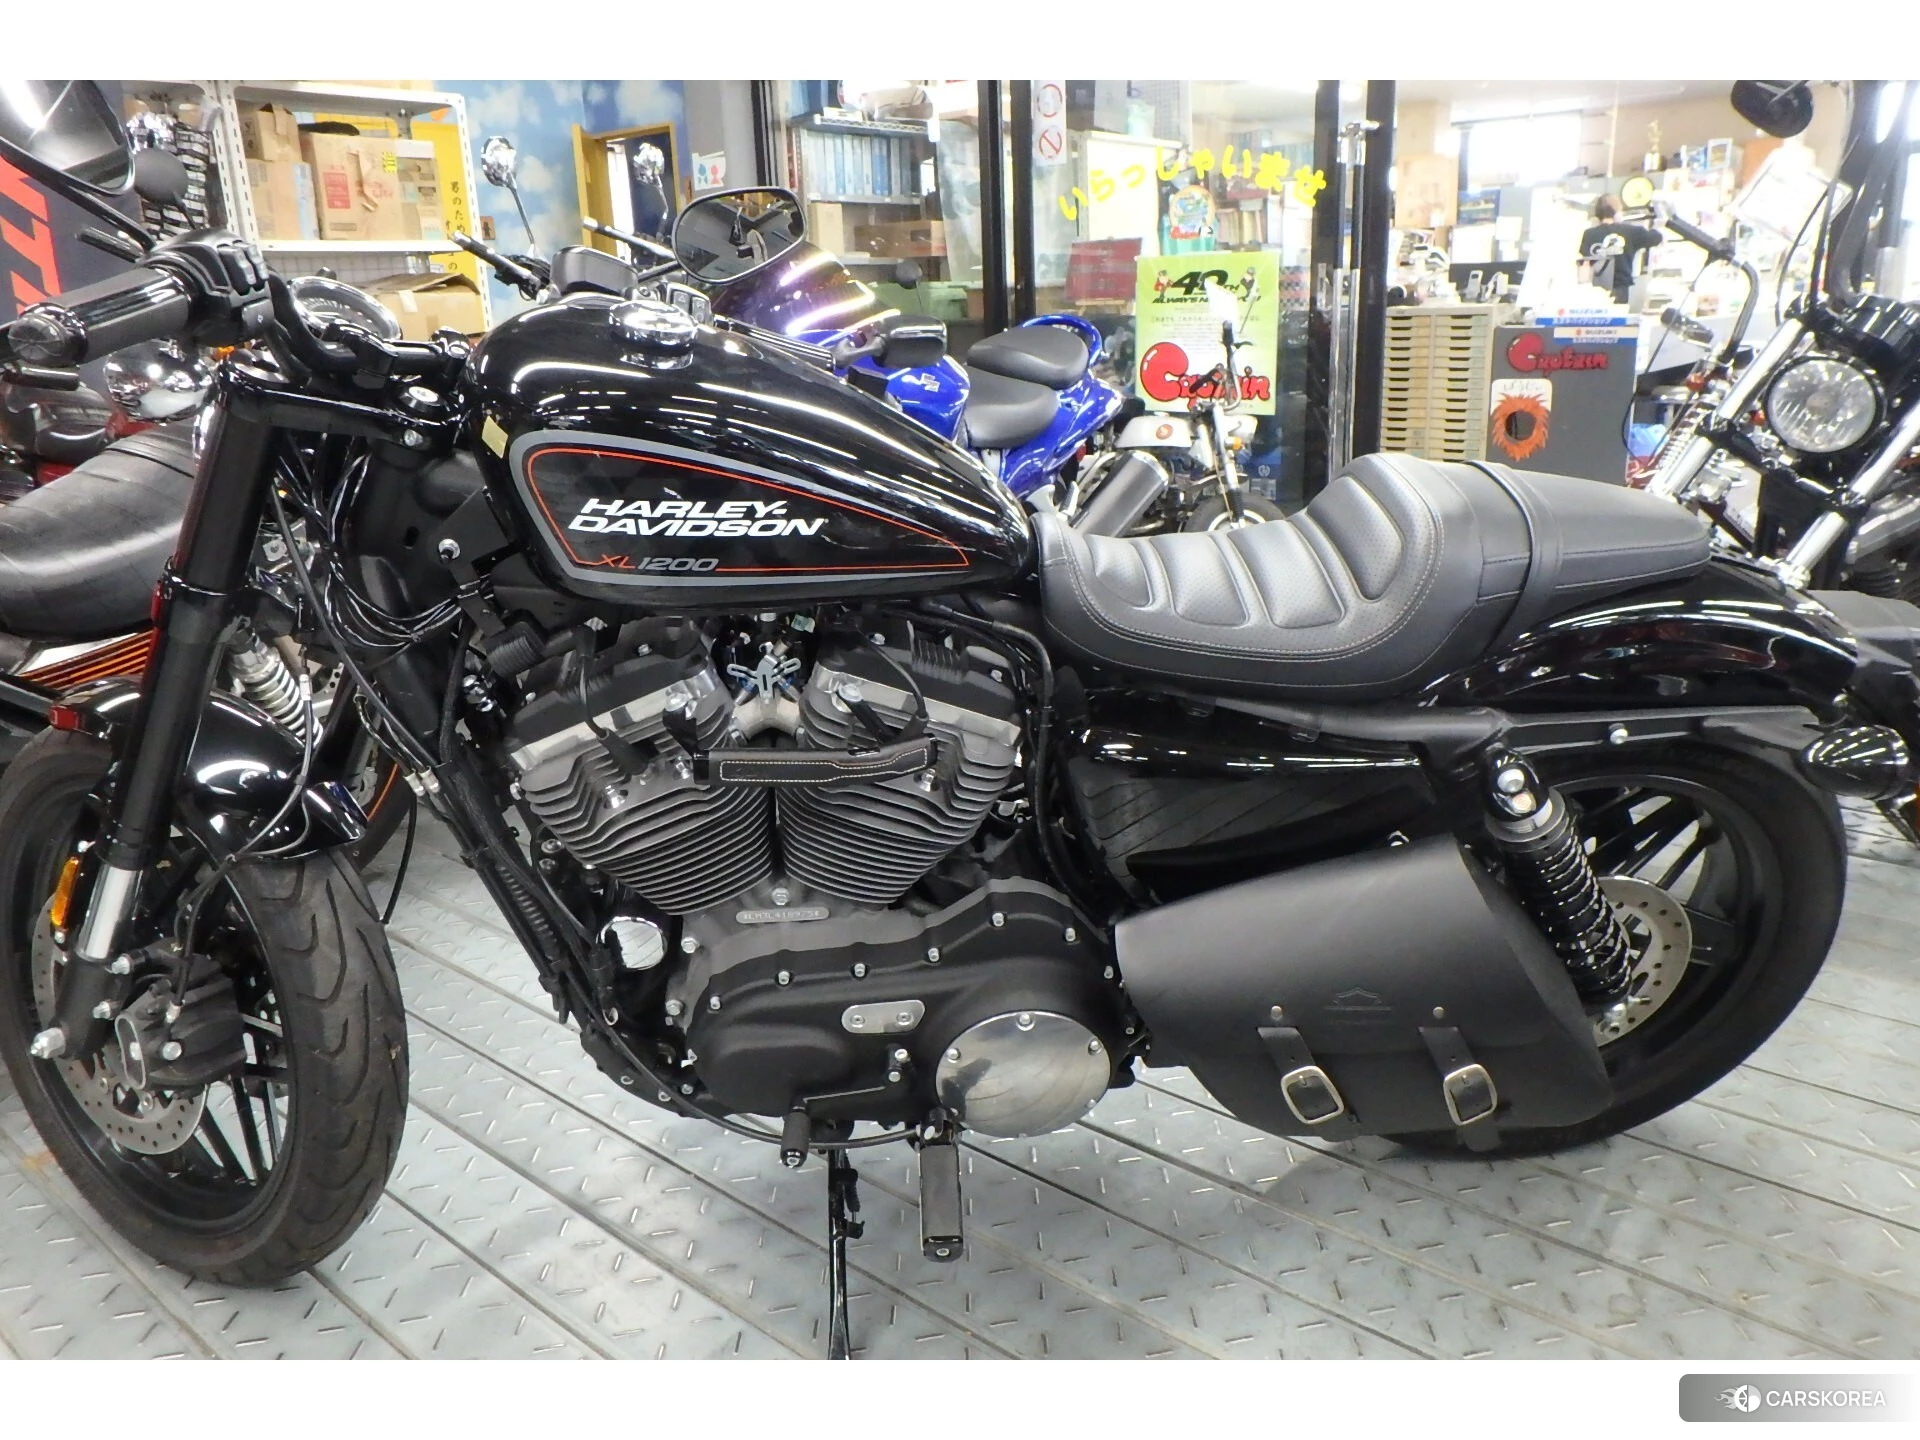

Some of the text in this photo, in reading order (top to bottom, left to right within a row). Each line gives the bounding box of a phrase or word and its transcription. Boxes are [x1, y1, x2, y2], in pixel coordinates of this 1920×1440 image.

[1058, 144, 1327, 221] いらっしゃいませ
[580, 498, 788, 519] HARLEY-
[568, 514, 829, 537] DAVIDSON
